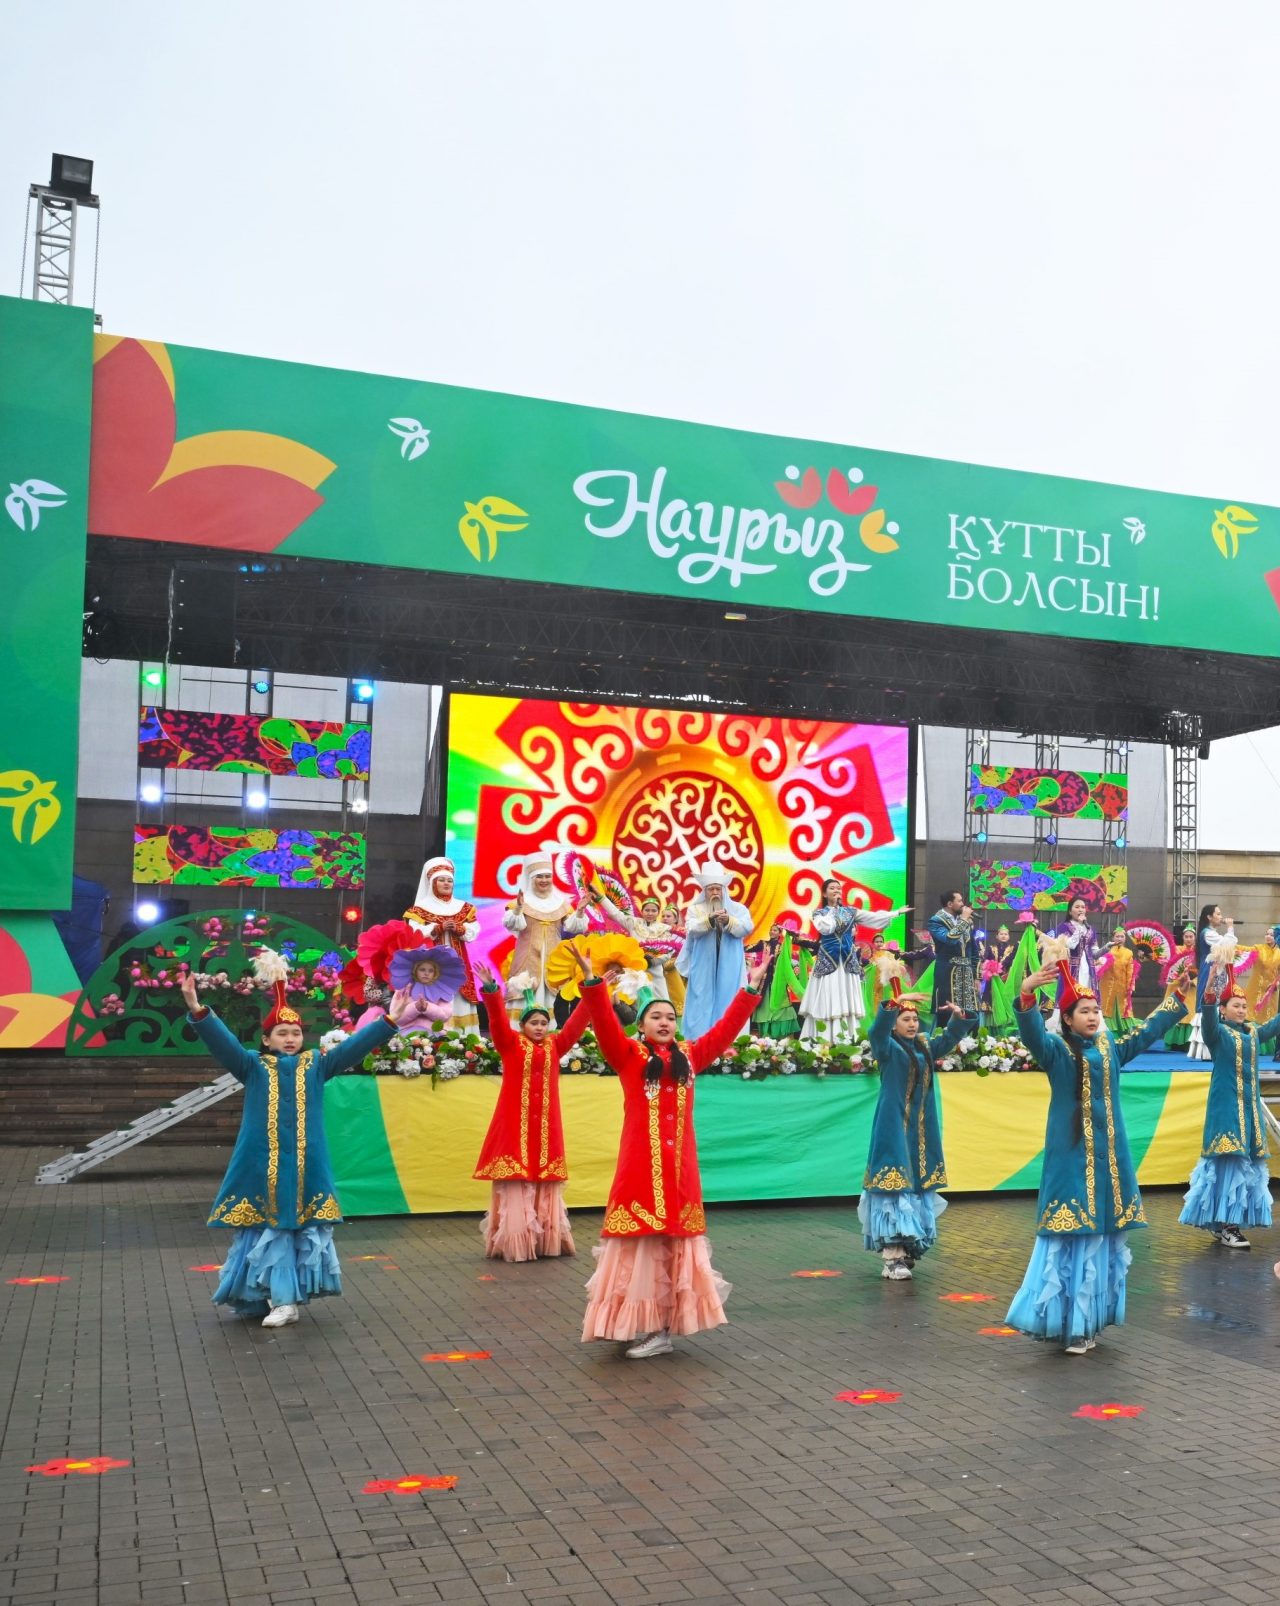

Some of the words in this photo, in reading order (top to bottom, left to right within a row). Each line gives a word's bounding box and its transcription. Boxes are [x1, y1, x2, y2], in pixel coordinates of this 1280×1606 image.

[573, 466, 873, 597] Наурыз
[947, 513, 1112, 568] ҚҰТТЫ
[946, 562, 1160, 621] БОЛСЫН!
